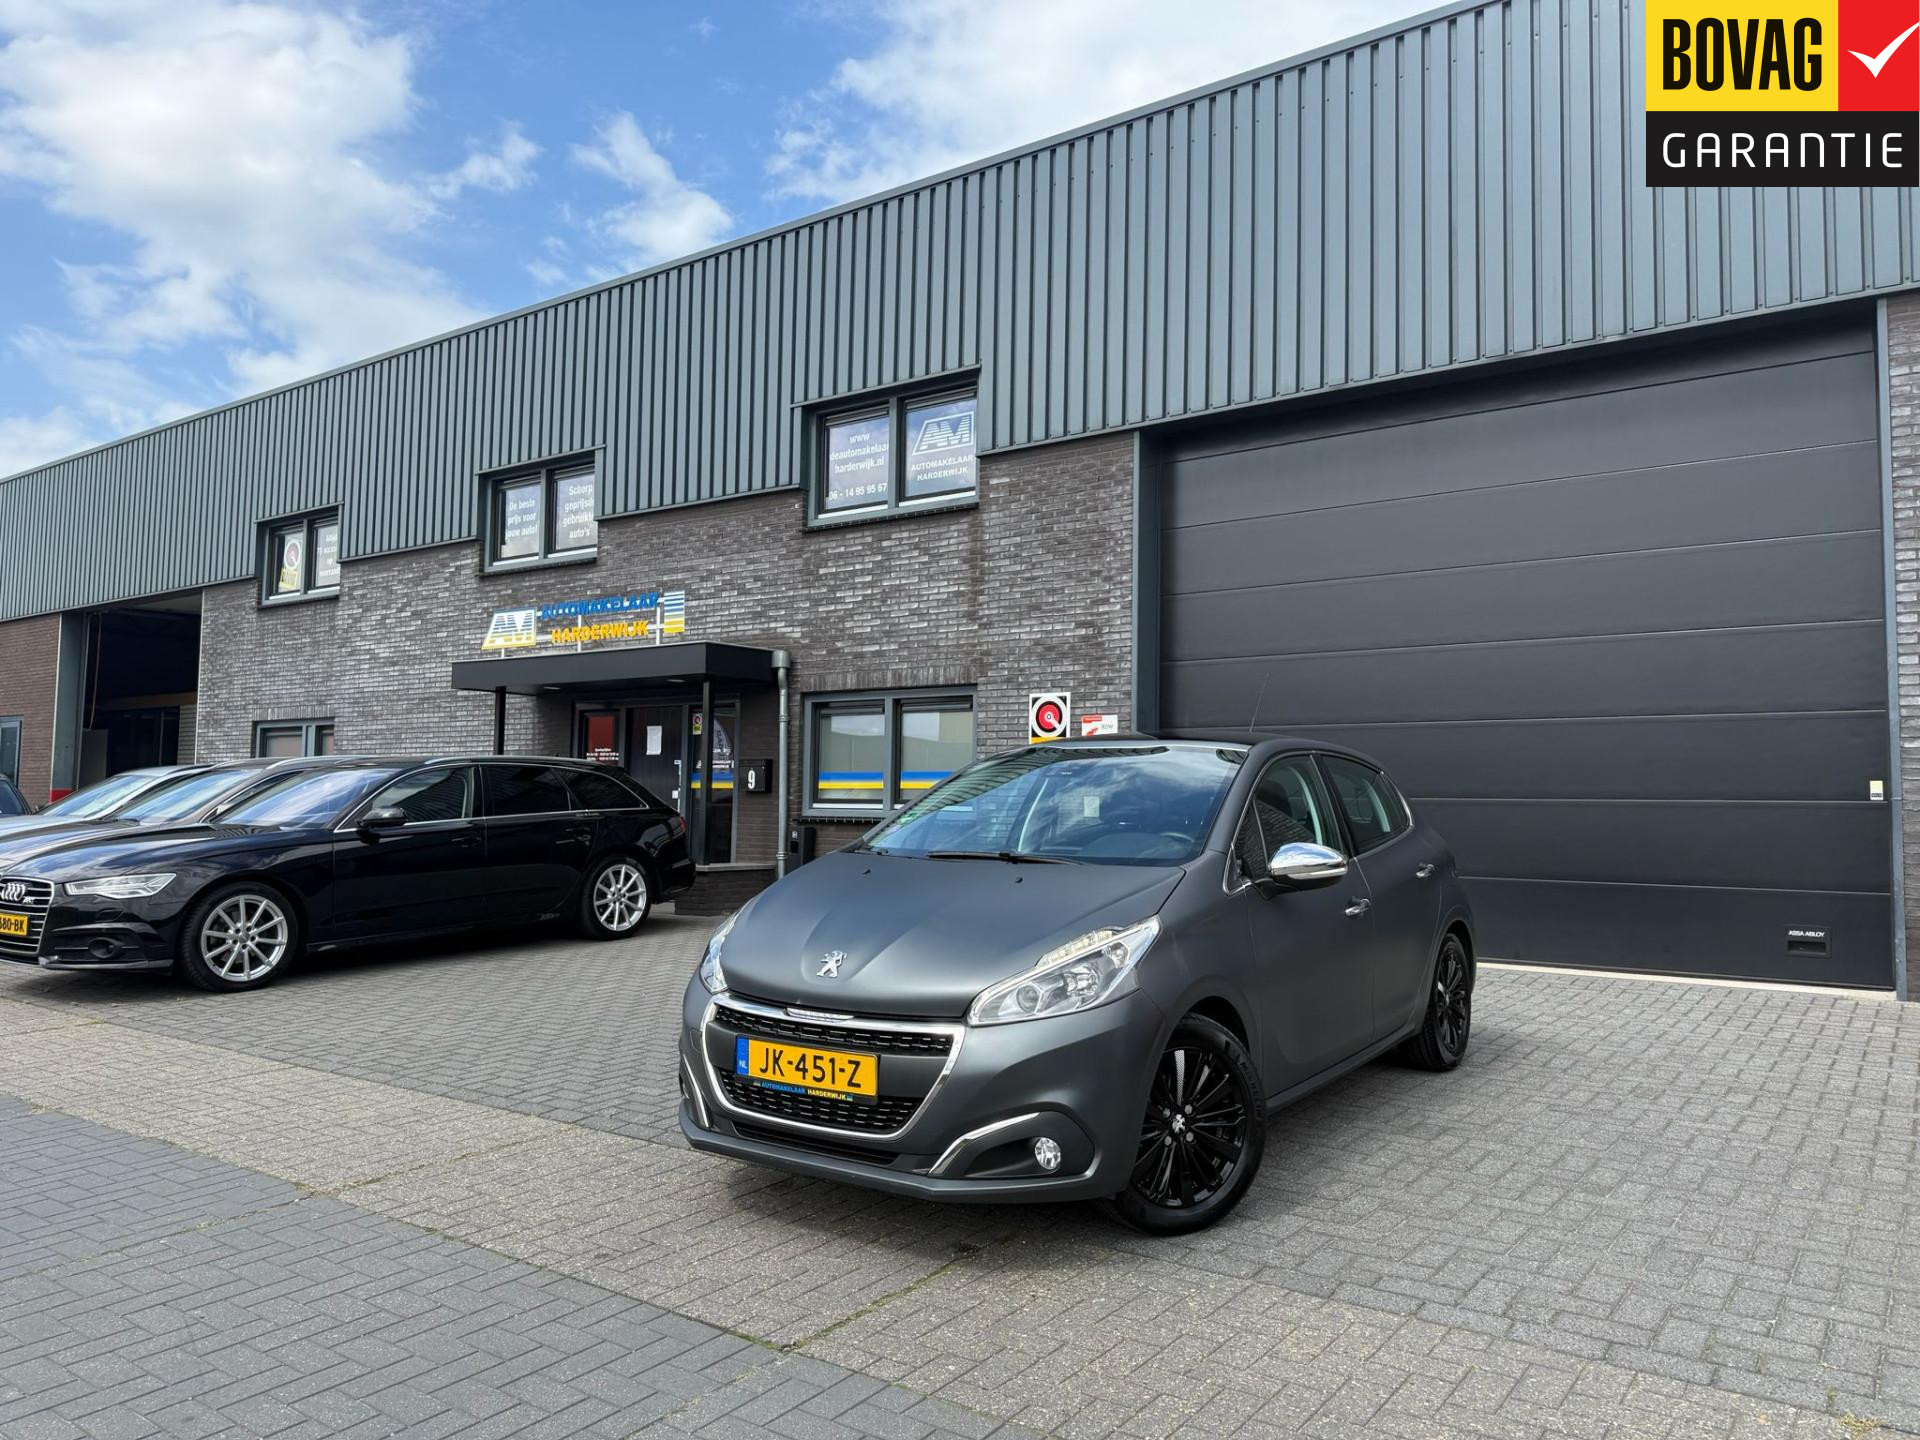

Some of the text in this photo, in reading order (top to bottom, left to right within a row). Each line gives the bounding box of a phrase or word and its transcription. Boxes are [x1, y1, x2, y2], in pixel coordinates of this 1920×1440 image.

[849, 432, 870, 444] www
[834, 455, 885, 474] harderwijk.nl
[911, 454, 973, 471] AUTOMAKELAAR
[917, 465, 969, 481] HARDERWIJK
[845, 487, 854, 498] 14
[518, 499, 536, 509] beste
[507, 512, 537, 527] prijs voor
[521, 524, 538, 536] auto!
[568, 527, 590, 538] auto's
[540, 591, 660, 620] AUTOMAKELAAR
[551, 620, 649, 643] HARDERWIJK
[747, 769, 756, 790] 9
[1788, 929, 1804, 937] ASSA
[738, 1047, 861, 1088] NL JK-451-Z
[761, 1081, 847, 1101] AUTOMAKELAAR HARDERWIJK
